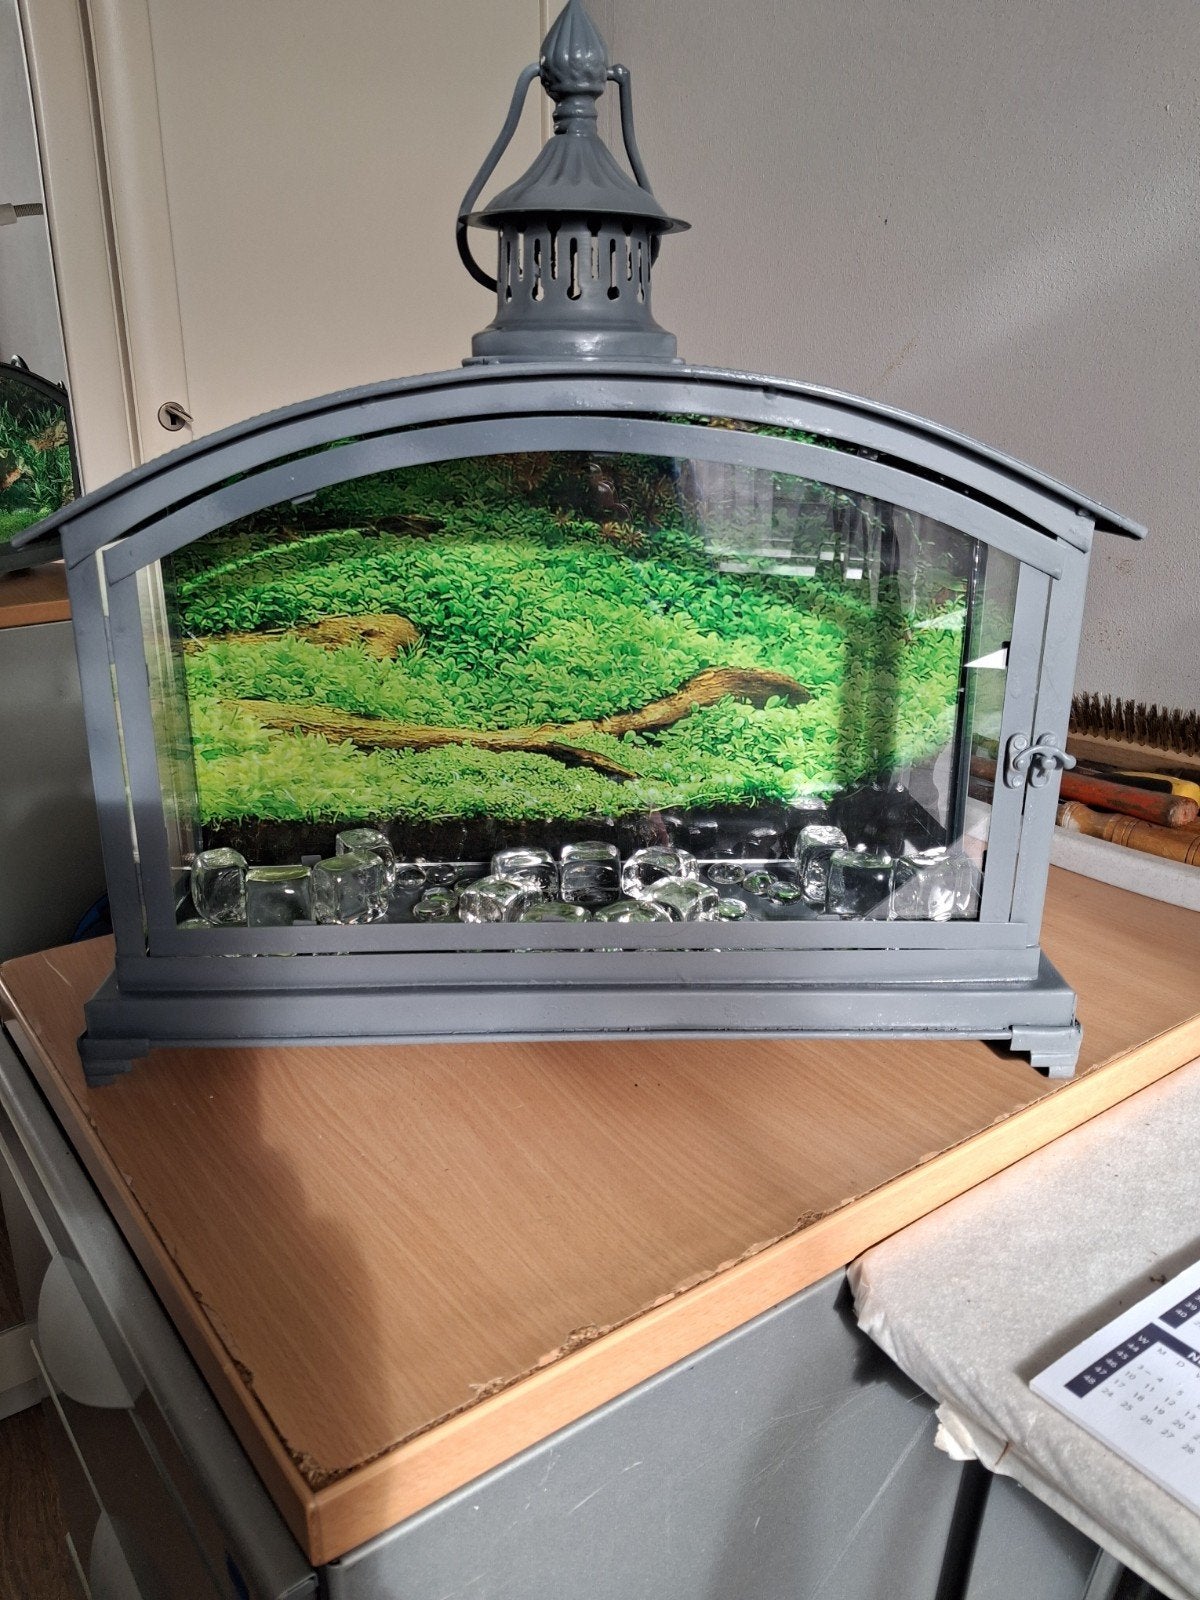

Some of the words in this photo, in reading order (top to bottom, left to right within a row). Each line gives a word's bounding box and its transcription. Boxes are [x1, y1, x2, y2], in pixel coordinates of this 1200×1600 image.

[1116, 1350, 1129, 1360] 45
[1094, 1366, 1108, 1375] 47
[1113, 1378, 1126, 1388] 17
[1132, 1391, 1145, 1402] 18
[1152, 1405, 1165, 1415] 19
[1172, 1419, 1186, 1430] 20
[1101, 1387, 1114, 1398] 24
[1120, 1400, 1133, 1411] 25
[1160, 1429, 1175, 1438] 27
[1124, 1371, 1137, 1380] 10
[1144, 1383, 1155, 1392] 11
[1164, 1396, 1176, 1406] 12
[1184, 1410, 1197, 1421] 13
